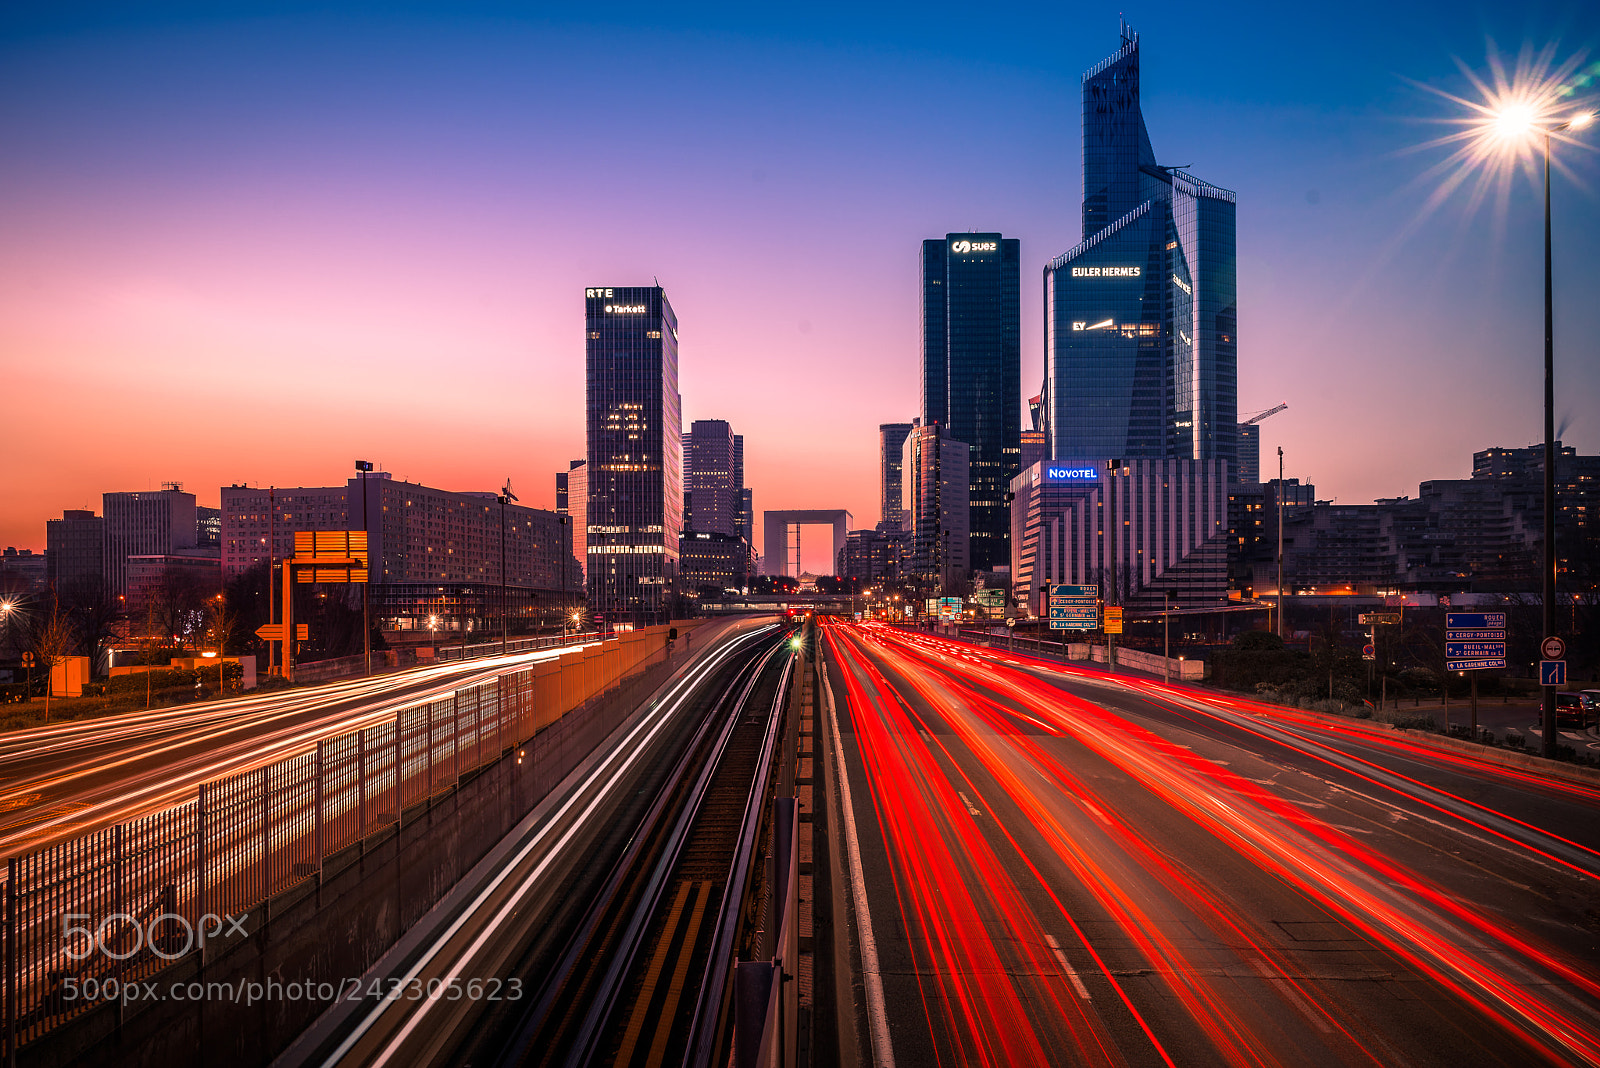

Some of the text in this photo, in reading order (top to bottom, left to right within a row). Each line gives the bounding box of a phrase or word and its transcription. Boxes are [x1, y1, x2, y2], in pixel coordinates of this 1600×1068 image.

[1072, 267, 1141, 277] EULER HERMES
[586, 288, 613, 298] RTE
[613, 304, 646, 314] Tarkett
[1072, 321, 1086, 331] EY
[1049, 468, 1097, 478] NOVOTEL
